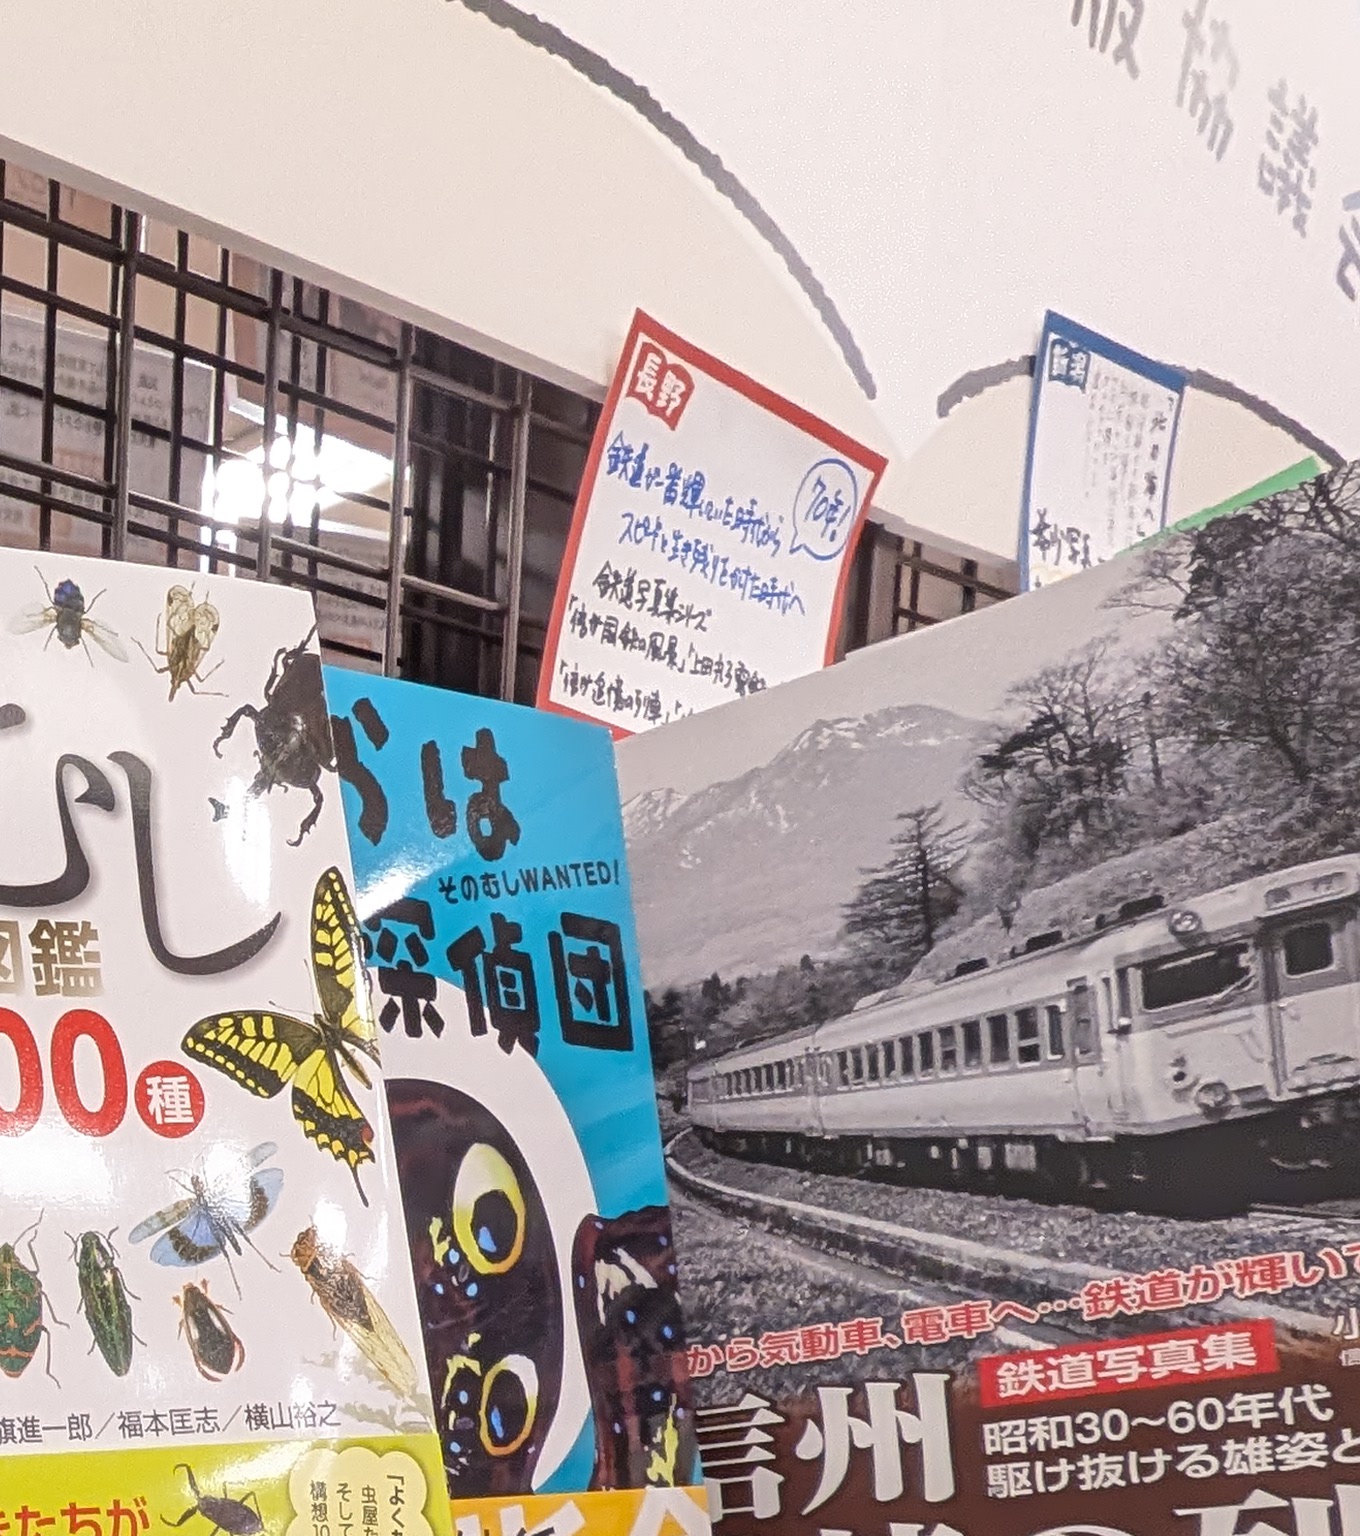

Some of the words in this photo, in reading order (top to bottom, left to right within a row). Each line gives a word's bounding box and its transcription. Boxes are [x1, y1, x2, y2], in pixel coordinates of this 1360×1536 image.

[994, 1331, 1257, 1400] 鉄道写真集
